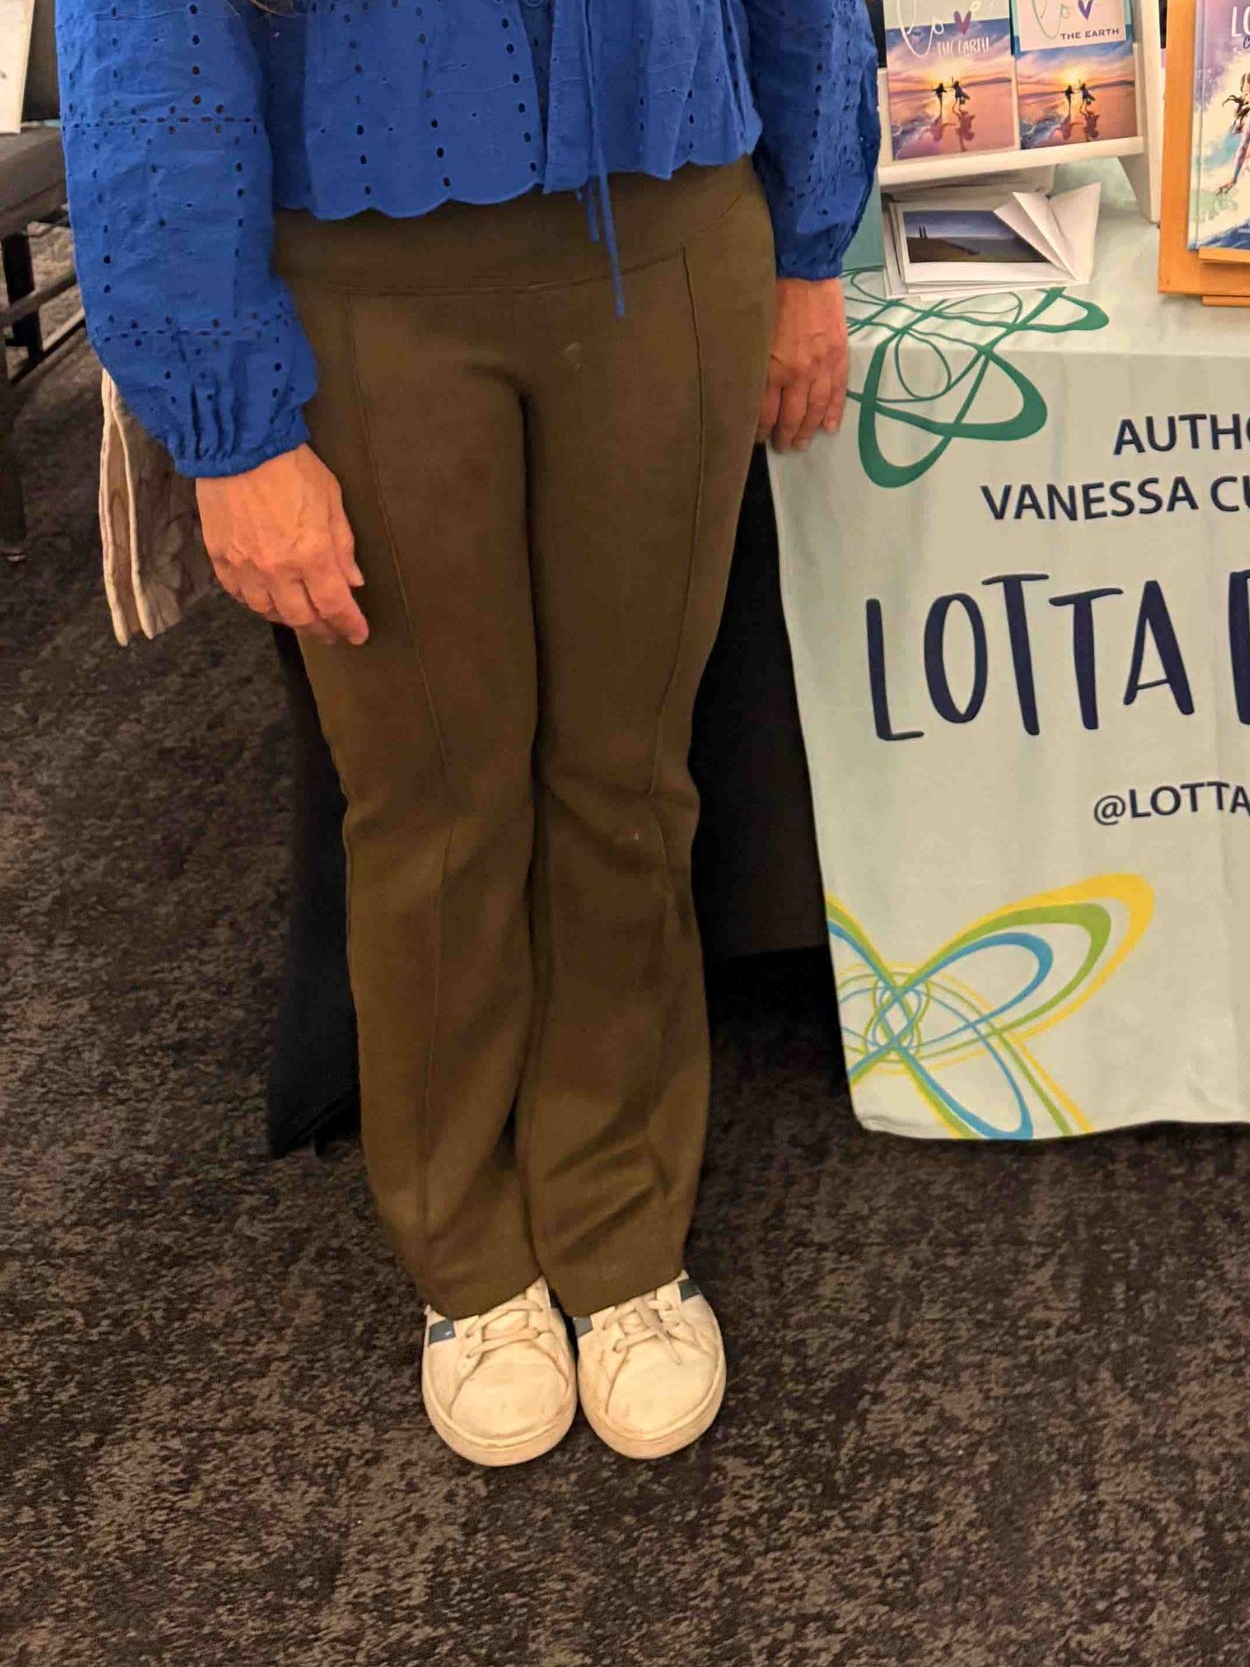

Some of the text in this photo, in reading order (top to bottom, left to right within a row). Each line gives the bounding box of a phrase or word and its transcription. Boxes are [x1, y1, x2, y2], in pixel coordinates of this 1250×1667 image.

[1060, 28, 1120, 41] THE EARTH
[980, 476, 1199, 522] VANESSA
[864, 572, 1196, 742] LOTTA
